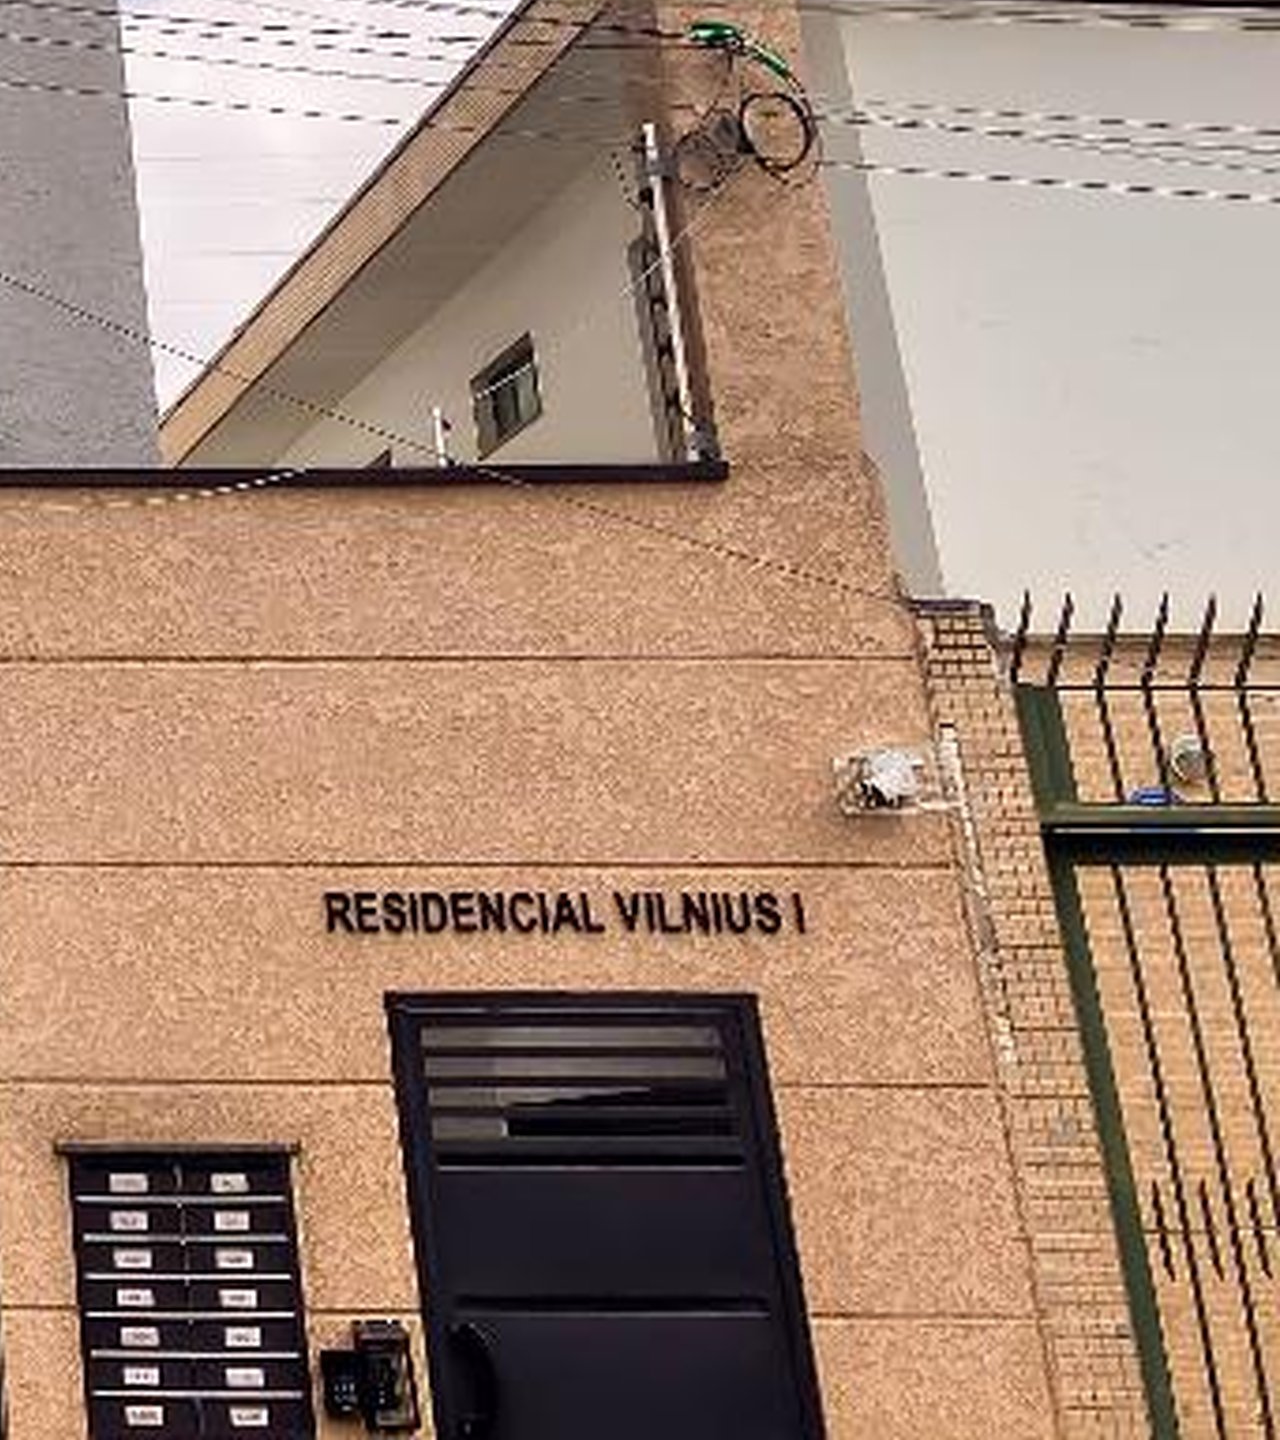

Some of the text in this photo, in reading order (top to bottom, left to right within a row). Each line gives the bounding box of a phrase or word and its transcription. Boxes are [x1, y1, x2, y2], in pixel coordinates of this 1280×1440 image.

[323, 890, 807, 935] RESIDENCIAL VILNIUS I
